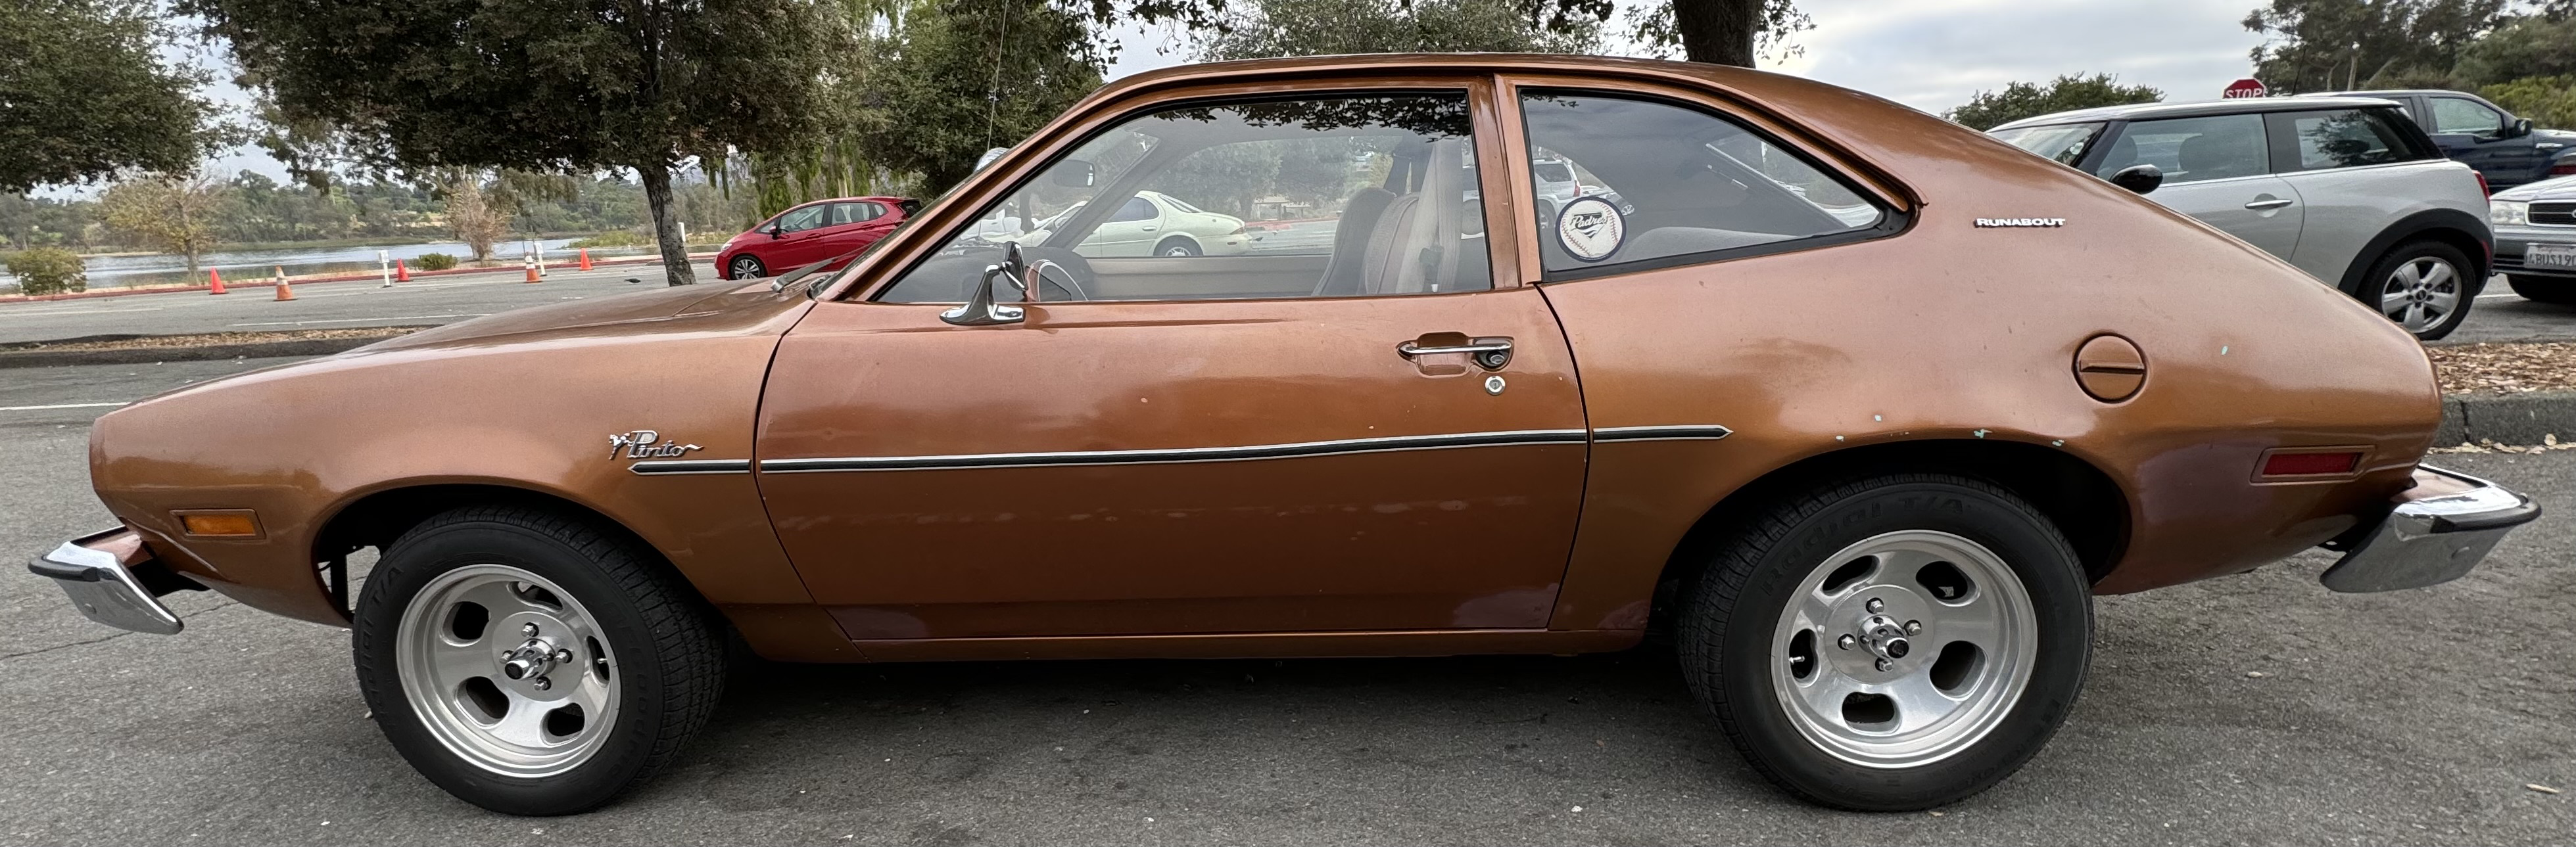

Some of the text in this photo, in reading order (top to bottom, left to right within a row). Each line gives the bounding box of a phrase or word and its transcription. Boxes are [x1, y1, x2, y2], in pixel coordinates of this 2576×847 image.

[2226, 87, 2262, 98] STOP
[1976, 217, 2066, 227] RUNABOUT
[627, 430, 705, 459] Pinto
[1760, 502, 1881, 597] Radial
